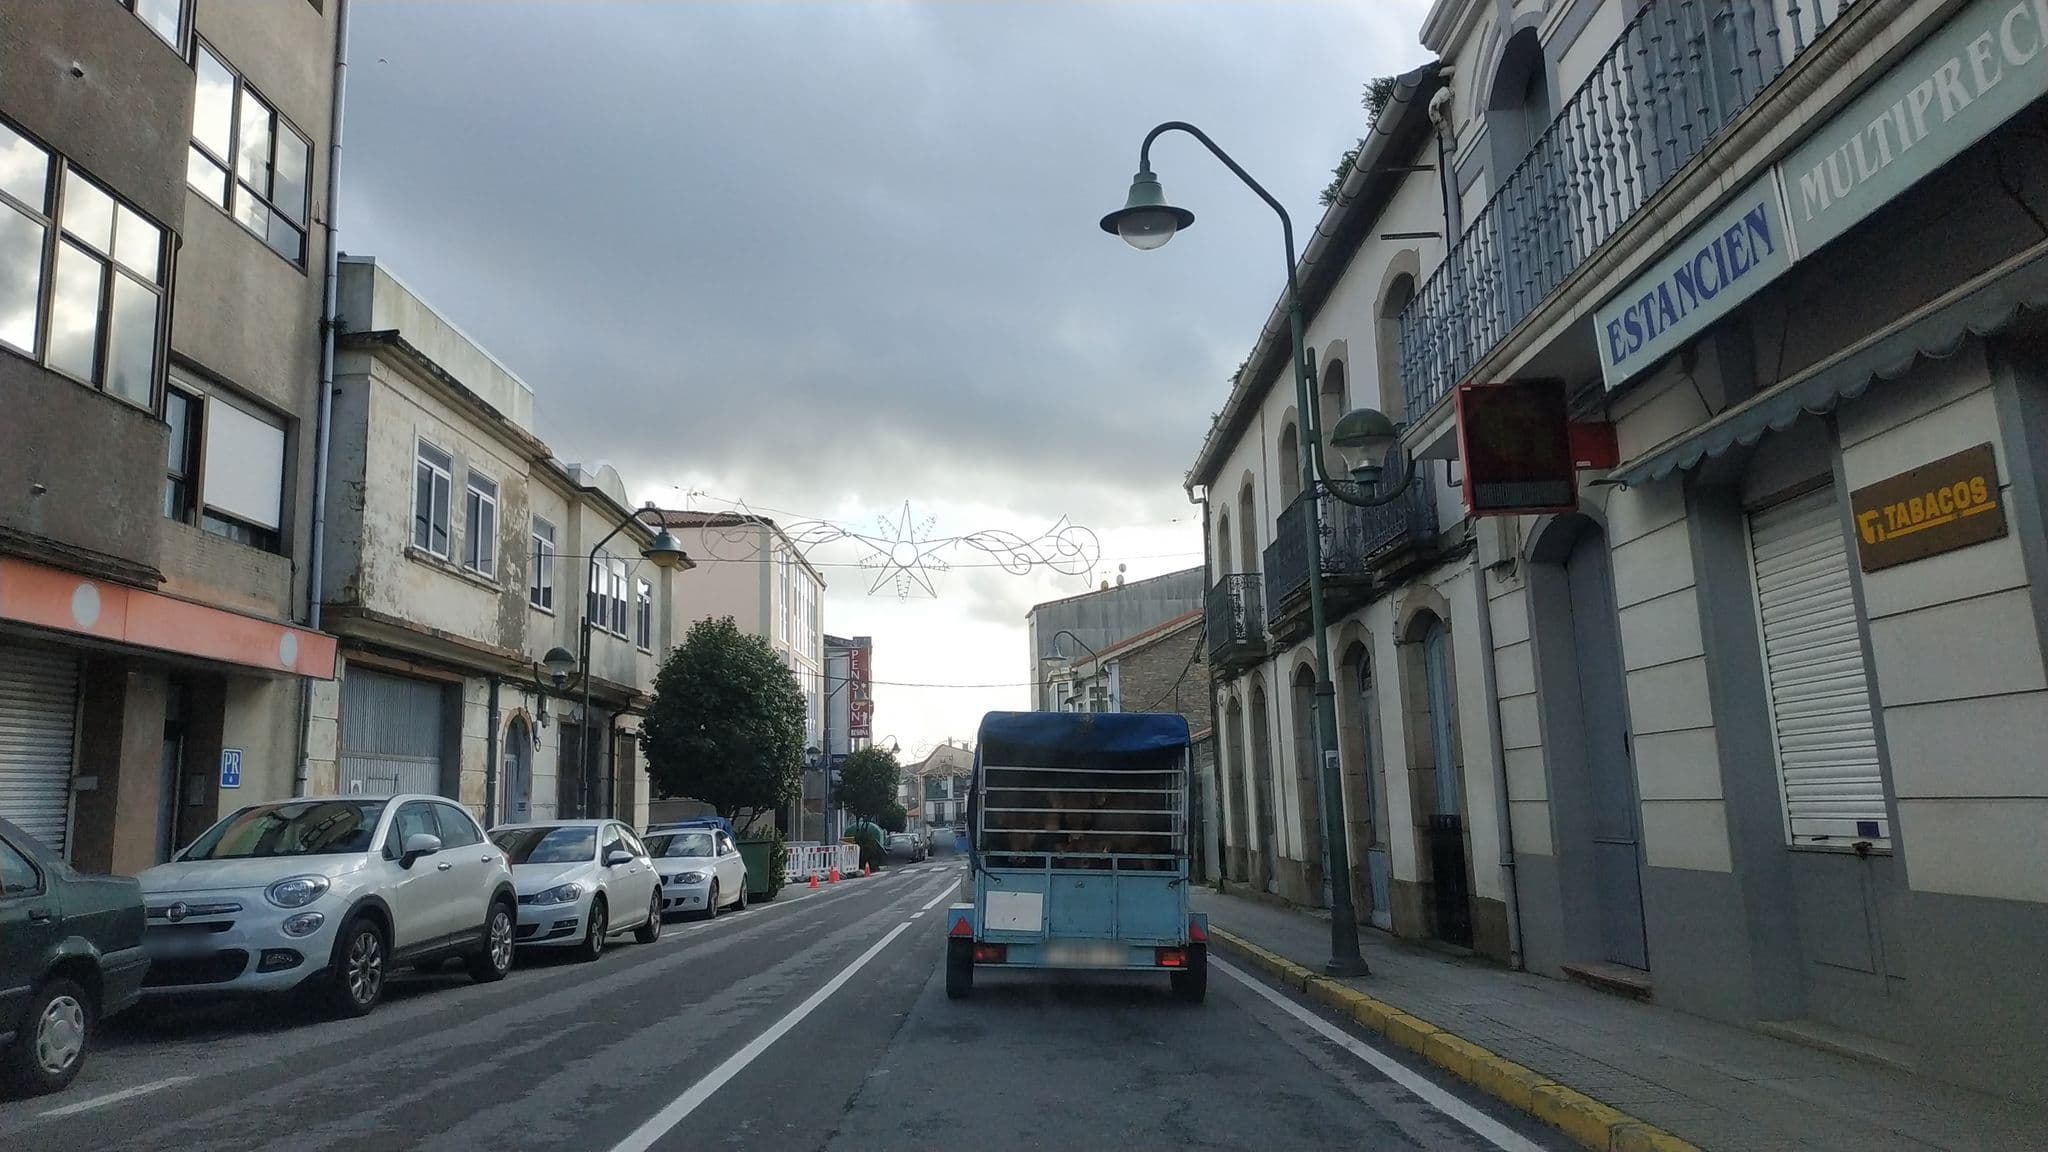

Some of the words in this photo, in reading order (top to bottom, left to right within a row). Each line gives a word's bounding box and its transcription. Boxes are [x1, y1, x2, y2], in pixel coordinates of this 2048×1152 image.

[1606, 202, 1776, 367] ESTANCIEN
[1884, 476, 1988, 530] TABACOS
[223, 752, 240, 775] PR
